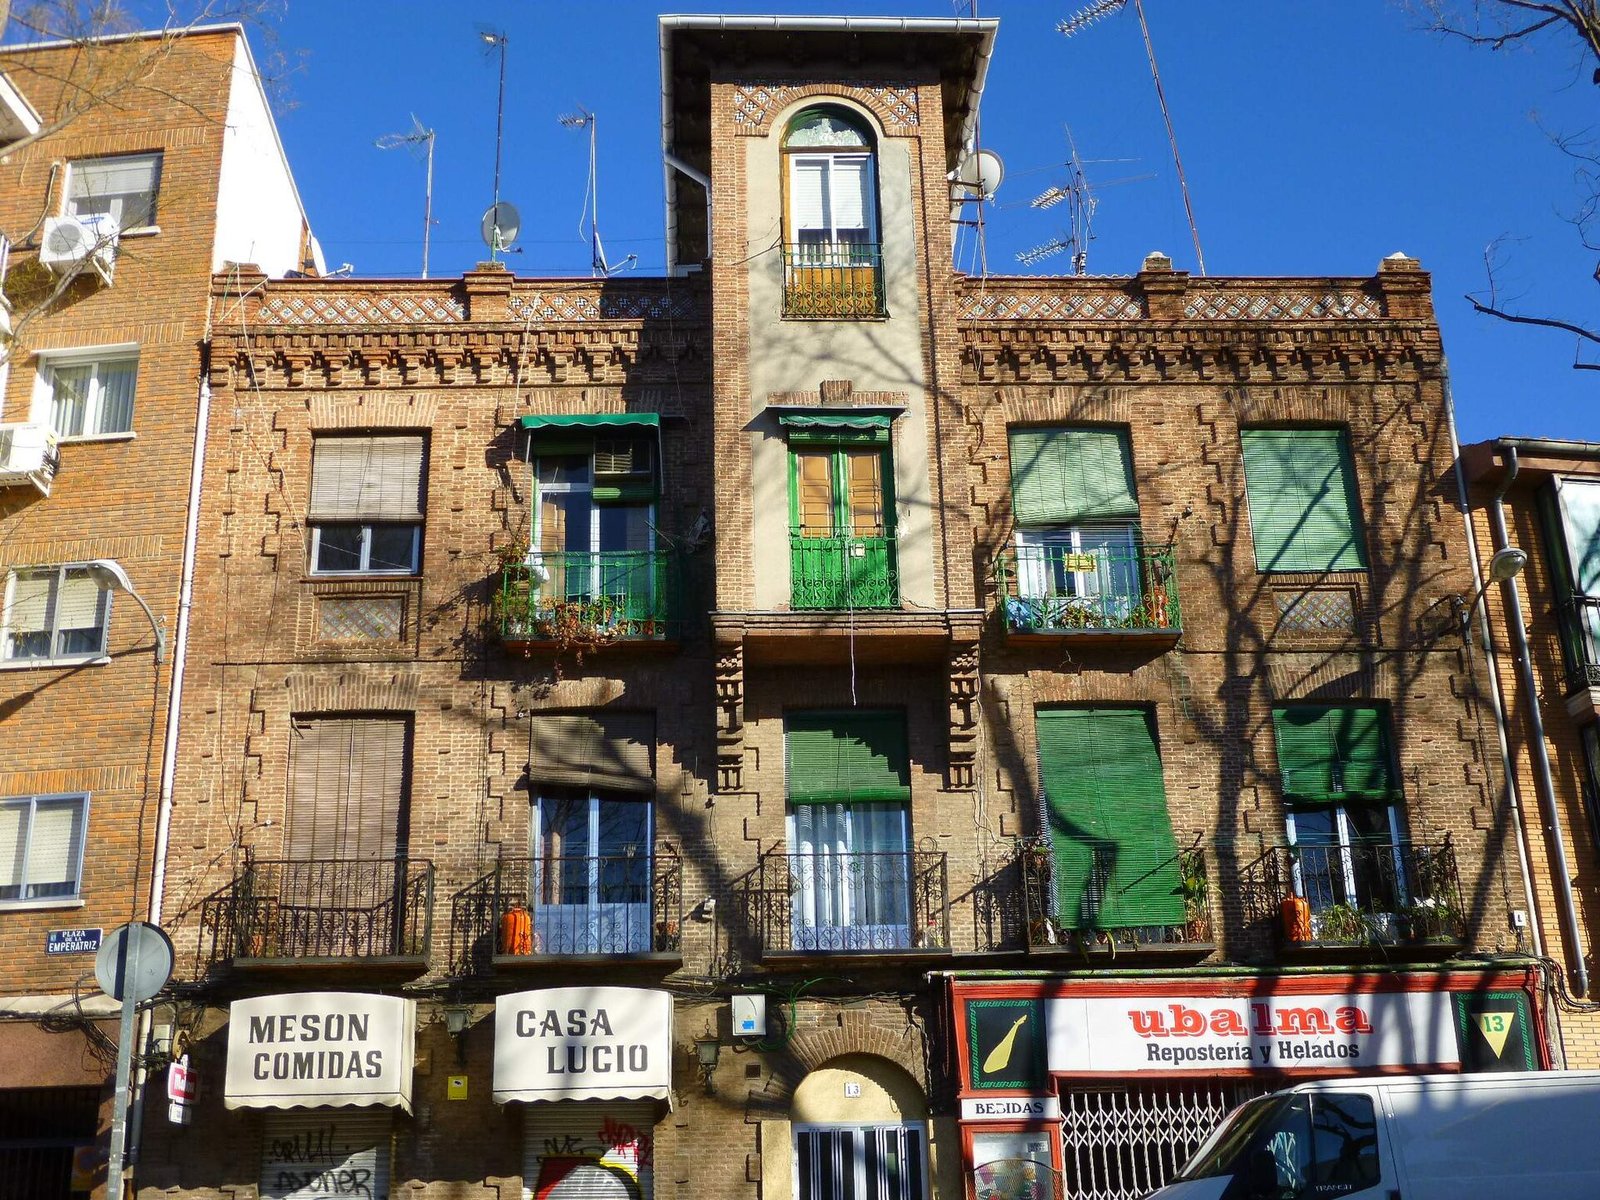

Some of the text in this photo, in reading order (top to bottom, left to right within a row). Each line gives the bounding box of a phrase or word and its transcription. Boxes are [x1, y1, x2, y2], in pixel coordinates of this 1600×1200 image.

[49, 940, 97, 952] EMPERATRIZ
[249, 1014, 369, 1043] MESON
[516, 1009, 614, 1037] CASA
[1128, 1003, 1374, 1038] ubalma
[1484, 1015, 1505, 1032] 13
[254, 1050, 382, 1080] COMIDAS
[547, 1044, 648, 1074] LUCIO
[1147, 1040, 1359, 1065] Repostería y Helados
[847, 1085, 859, 1095] 13
